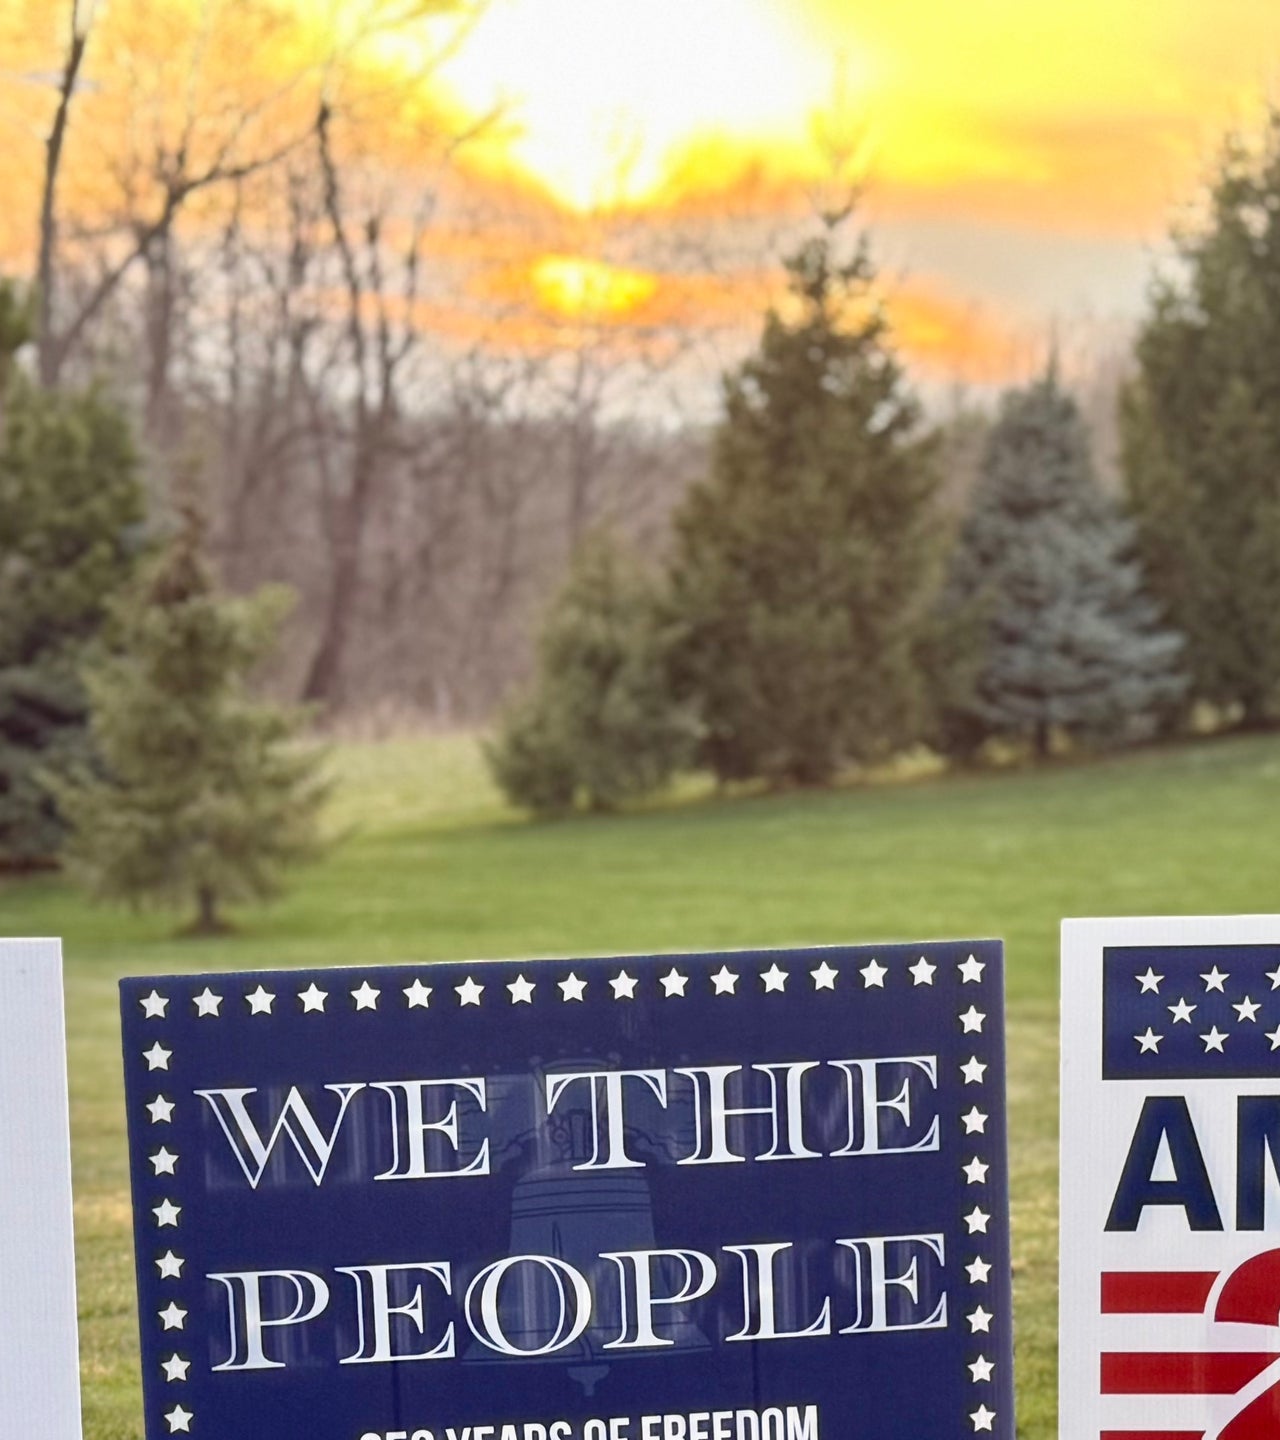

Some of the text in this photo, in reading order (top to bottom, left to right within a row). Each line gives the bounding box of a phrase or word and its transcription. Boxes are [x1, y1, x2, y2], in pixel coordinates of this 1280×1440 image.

[193, 1054, 942, 1190] WE THE
[205, 1232, 949, 1373] PEOPLE
